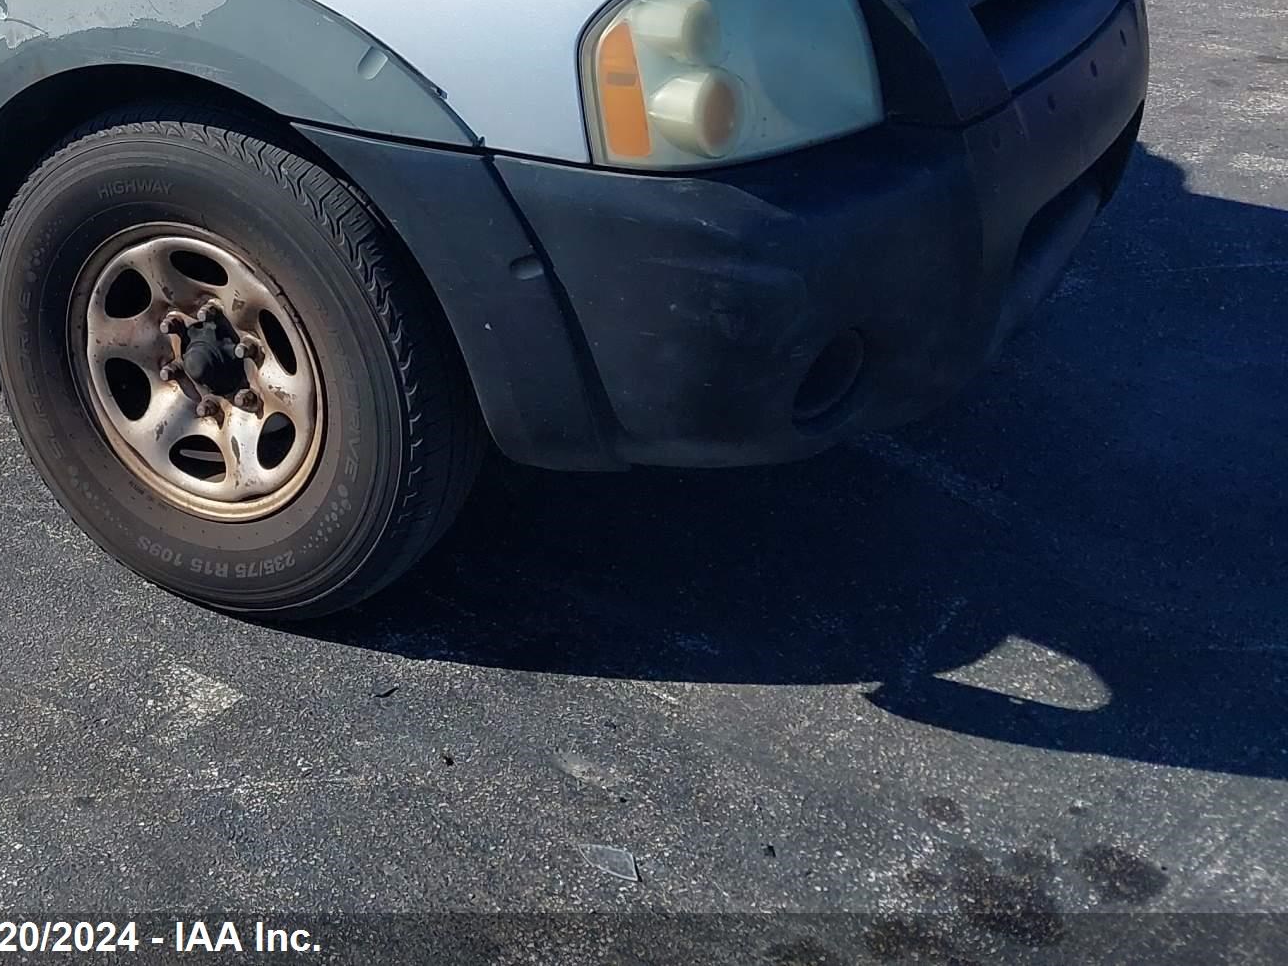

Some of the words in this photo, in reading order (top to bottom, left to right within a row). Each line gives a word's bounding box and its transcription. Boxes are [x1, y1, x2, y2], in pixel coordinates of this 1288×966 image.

[96, 177, 176, 200] HIGHWAY
[136, 535, 183, 567] 109S
[190, 557, 229, 579] R15
